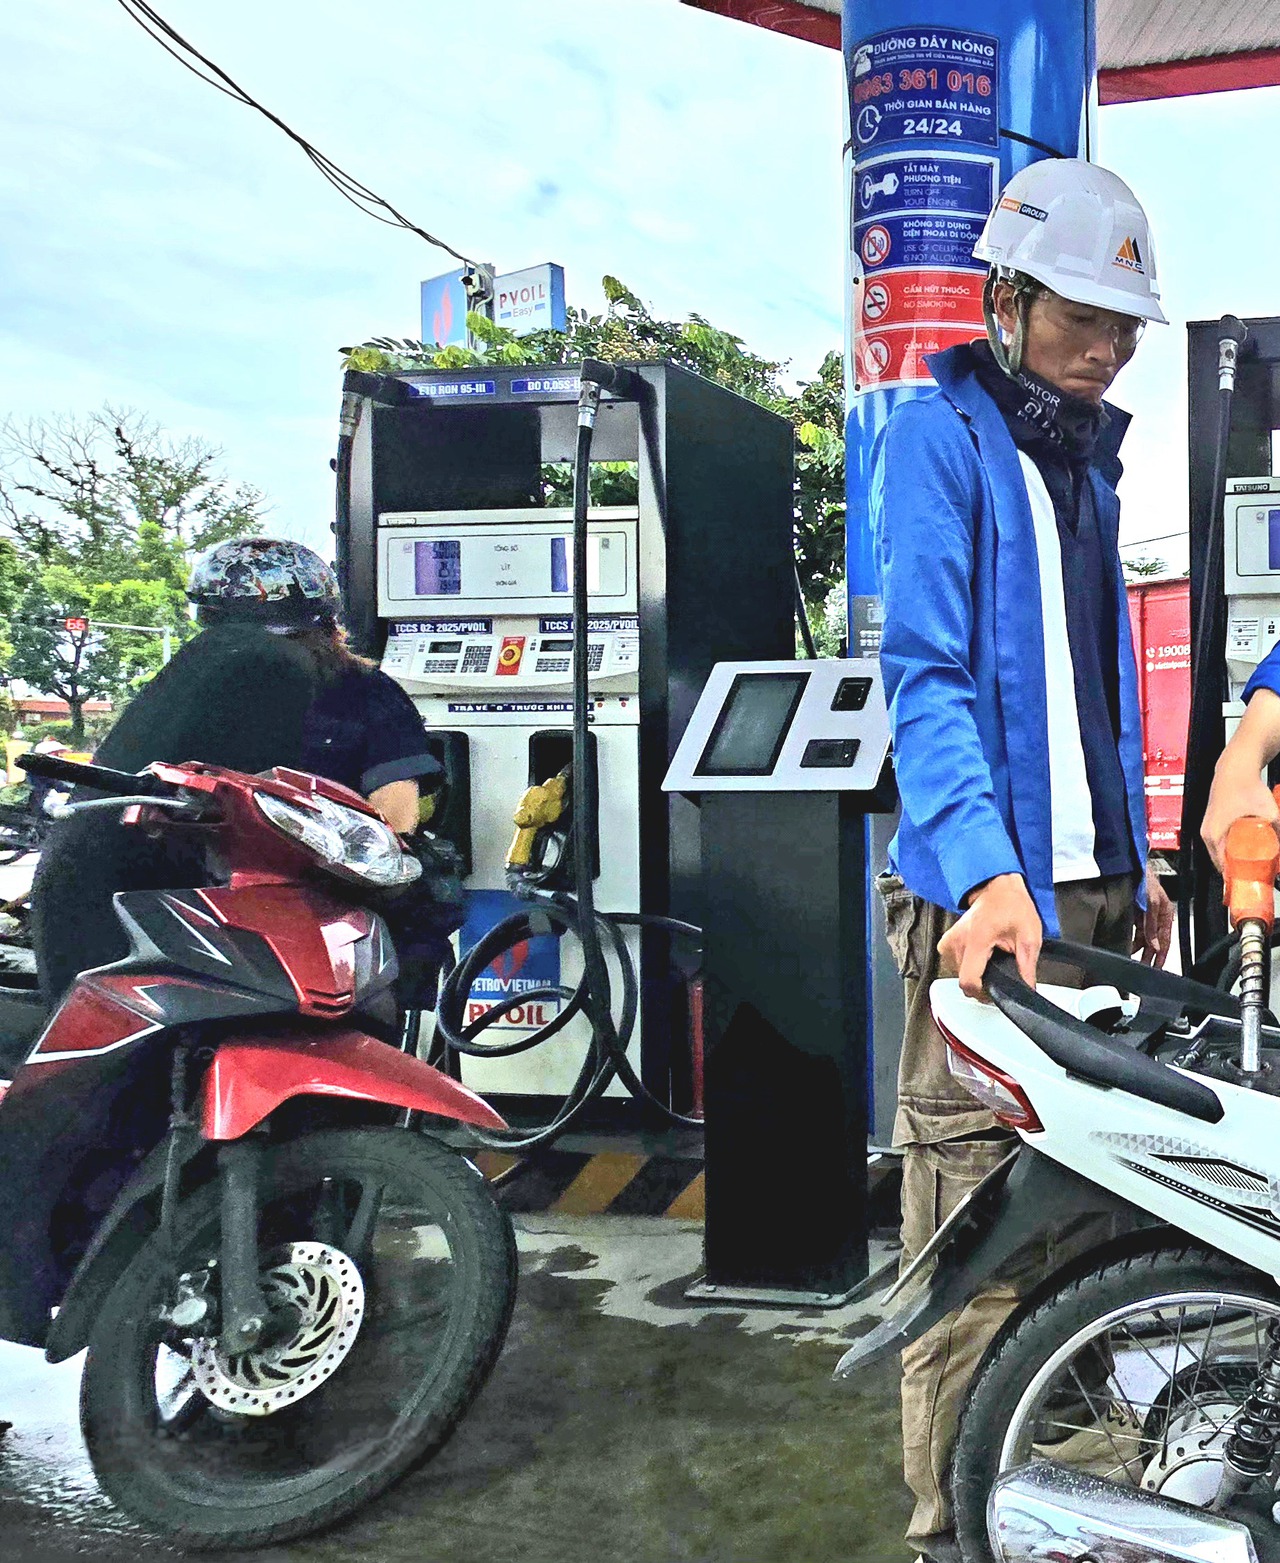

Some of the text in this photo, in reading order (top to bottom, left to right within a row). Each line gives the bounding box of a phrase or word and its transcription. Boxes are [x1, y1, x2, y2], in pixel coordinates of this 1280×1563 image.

[899, 69, 938, 91] 361
[947, 70, 991, 97] 016
[907, 100, 932, 108] GIAN
[903, 118, 962, 136] 24/24
[904, 199, 959, 207] YOUR ENGINE
[1021, 206, 1046, 219] GROUP
[911, 254, 928, 262] NOT
[929, 254, 970, 263] ALLOWED
[1115, 256, 1142, 270] MNC
[500, 284, 545, 309] PVOIL
[916, 301, 957, 309] SMOKING
[513, 306, 533, 318] Easy
[1235, 484, 1268, 492] TATSUNO
[395, 624, 418, 633] TCCS
[545, 621, 569, 630] TCCS
